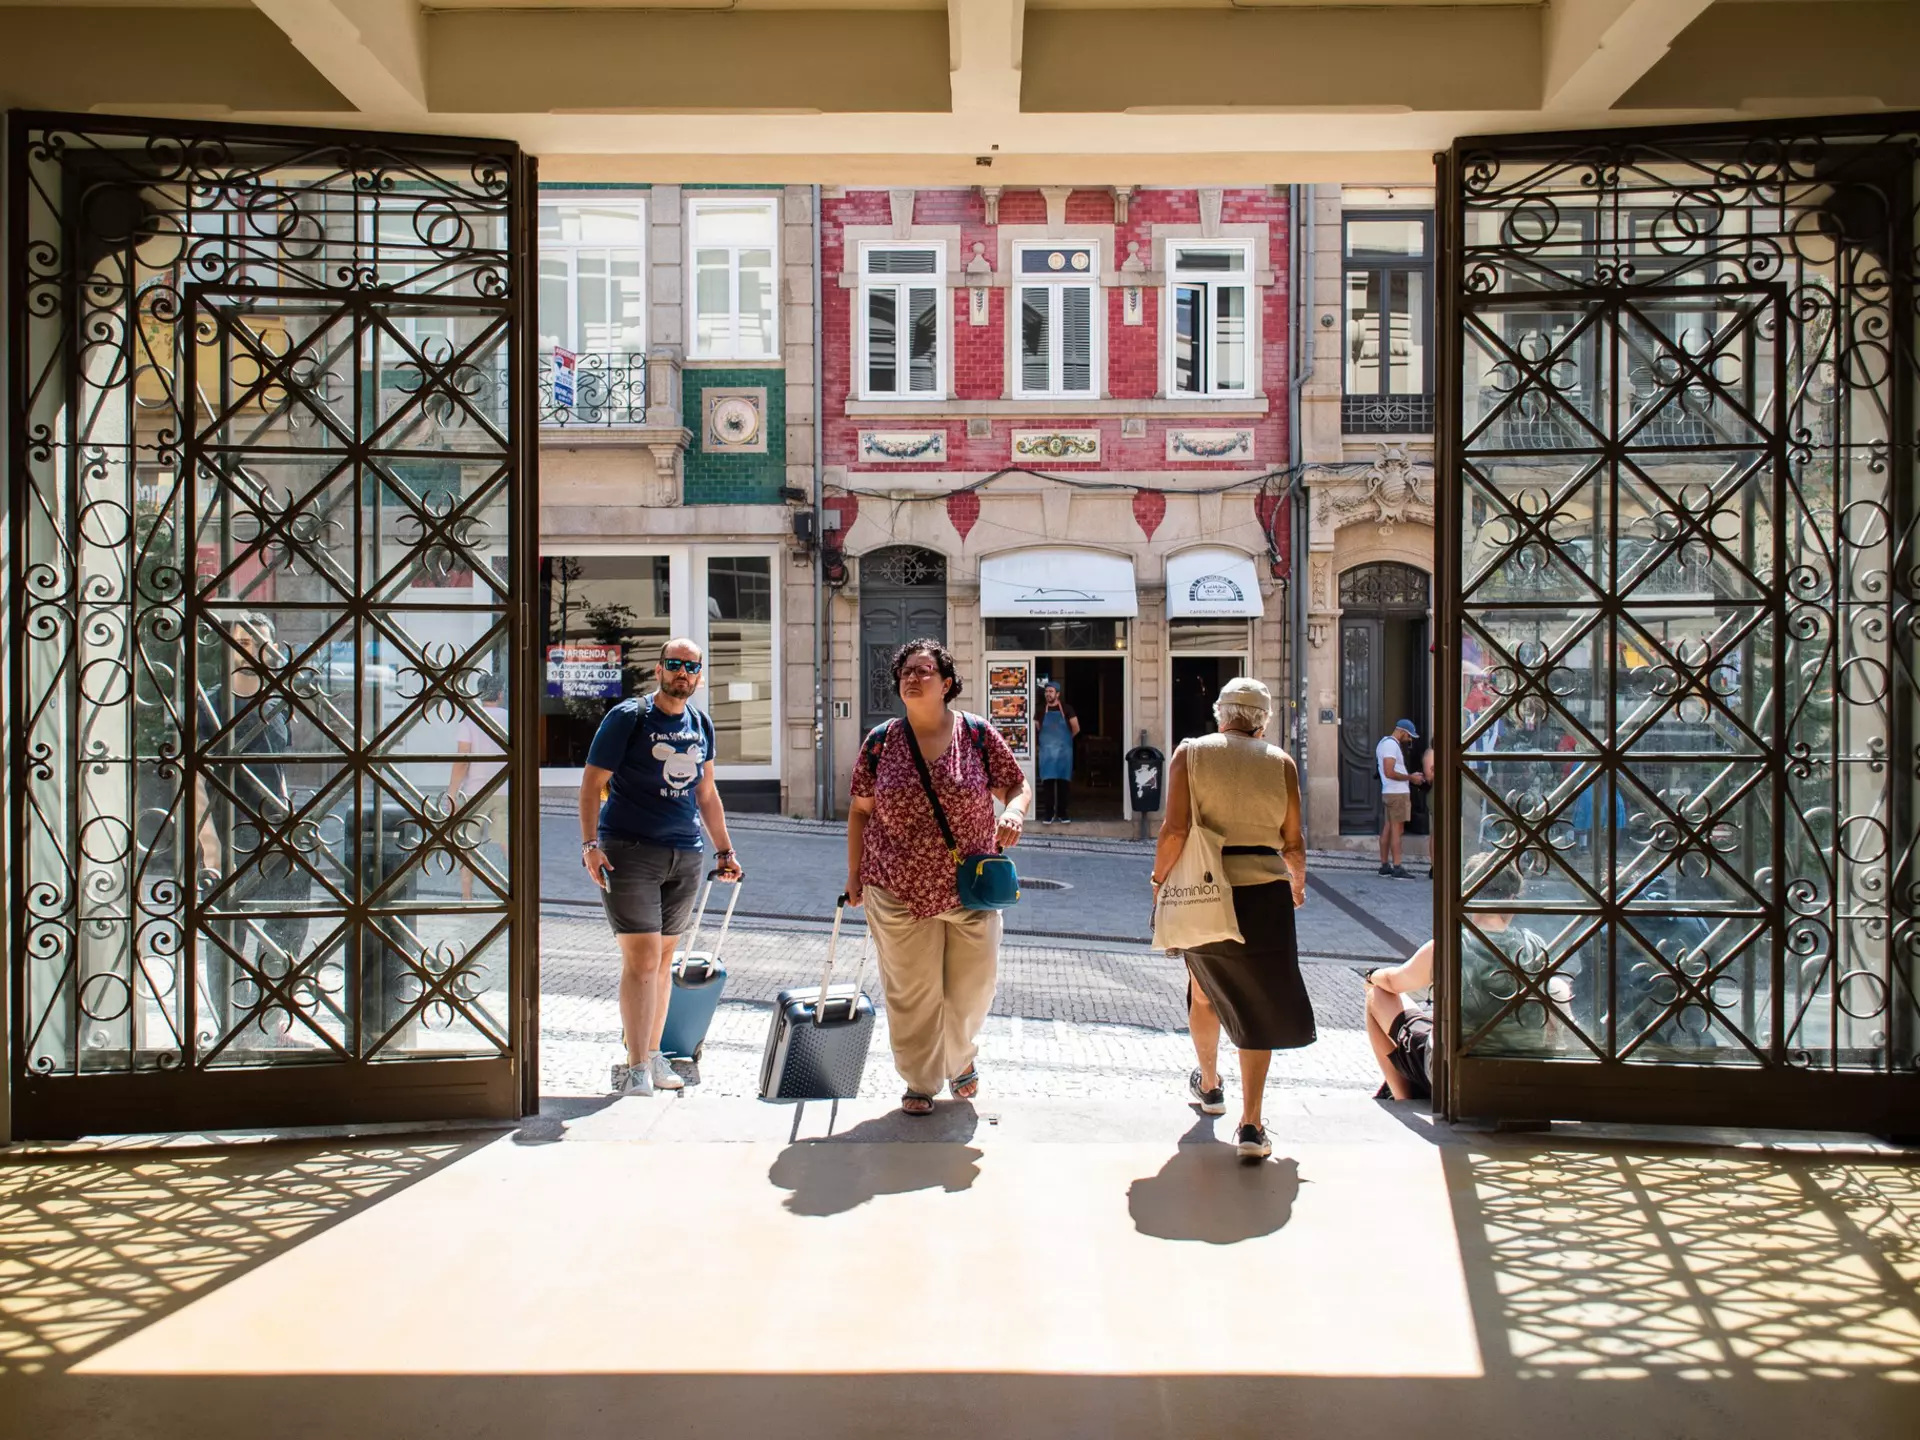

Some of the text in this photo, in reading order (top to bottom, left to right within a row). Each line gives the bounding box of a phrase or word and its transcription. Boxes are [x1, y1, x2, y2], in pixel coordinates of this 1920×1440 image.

[567, 649, 606, 658] ARRENDA
[551, 670, 618, 679] 963 074 002
[1183, 897, 1221, 905] communities
